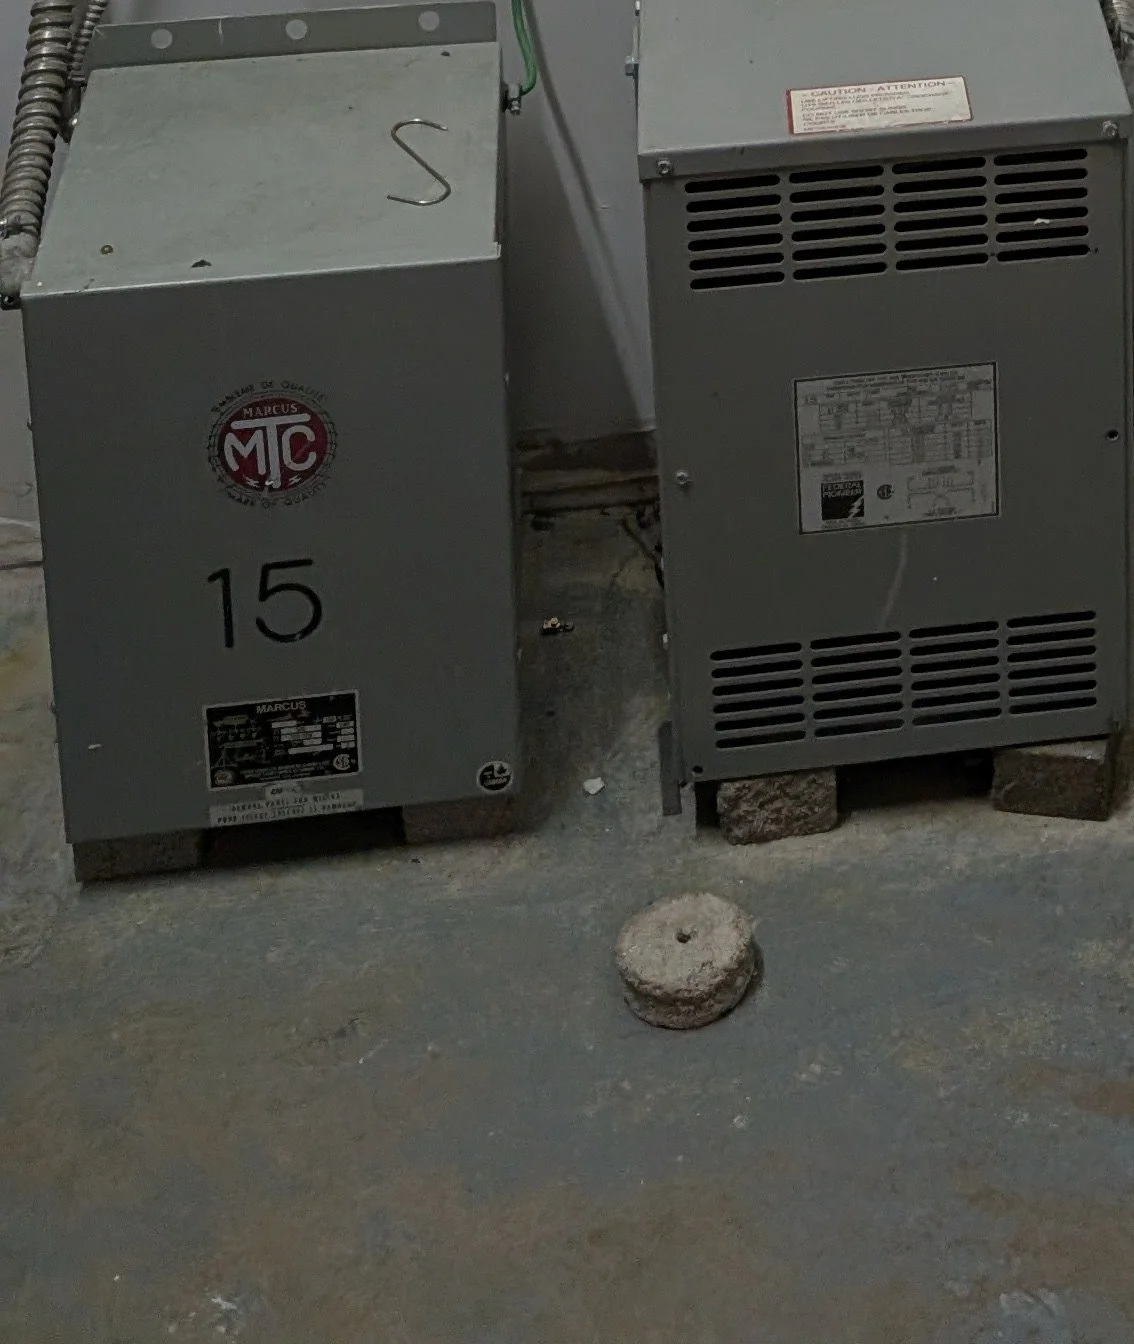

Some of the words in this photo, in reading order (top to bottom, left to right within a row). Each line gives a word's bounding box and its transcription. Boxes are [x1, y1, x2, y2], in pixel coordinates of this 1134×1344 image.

[810, 87, 866, 97] CAUTION
[877, 81, 946, 92] ATTENTION
[243, 403, 299, 418] MARCUS
[223, 413, 317, 489] MTC
[207, 558, 323, 649] 15
[255, 700, 308, 714] MARCUS
